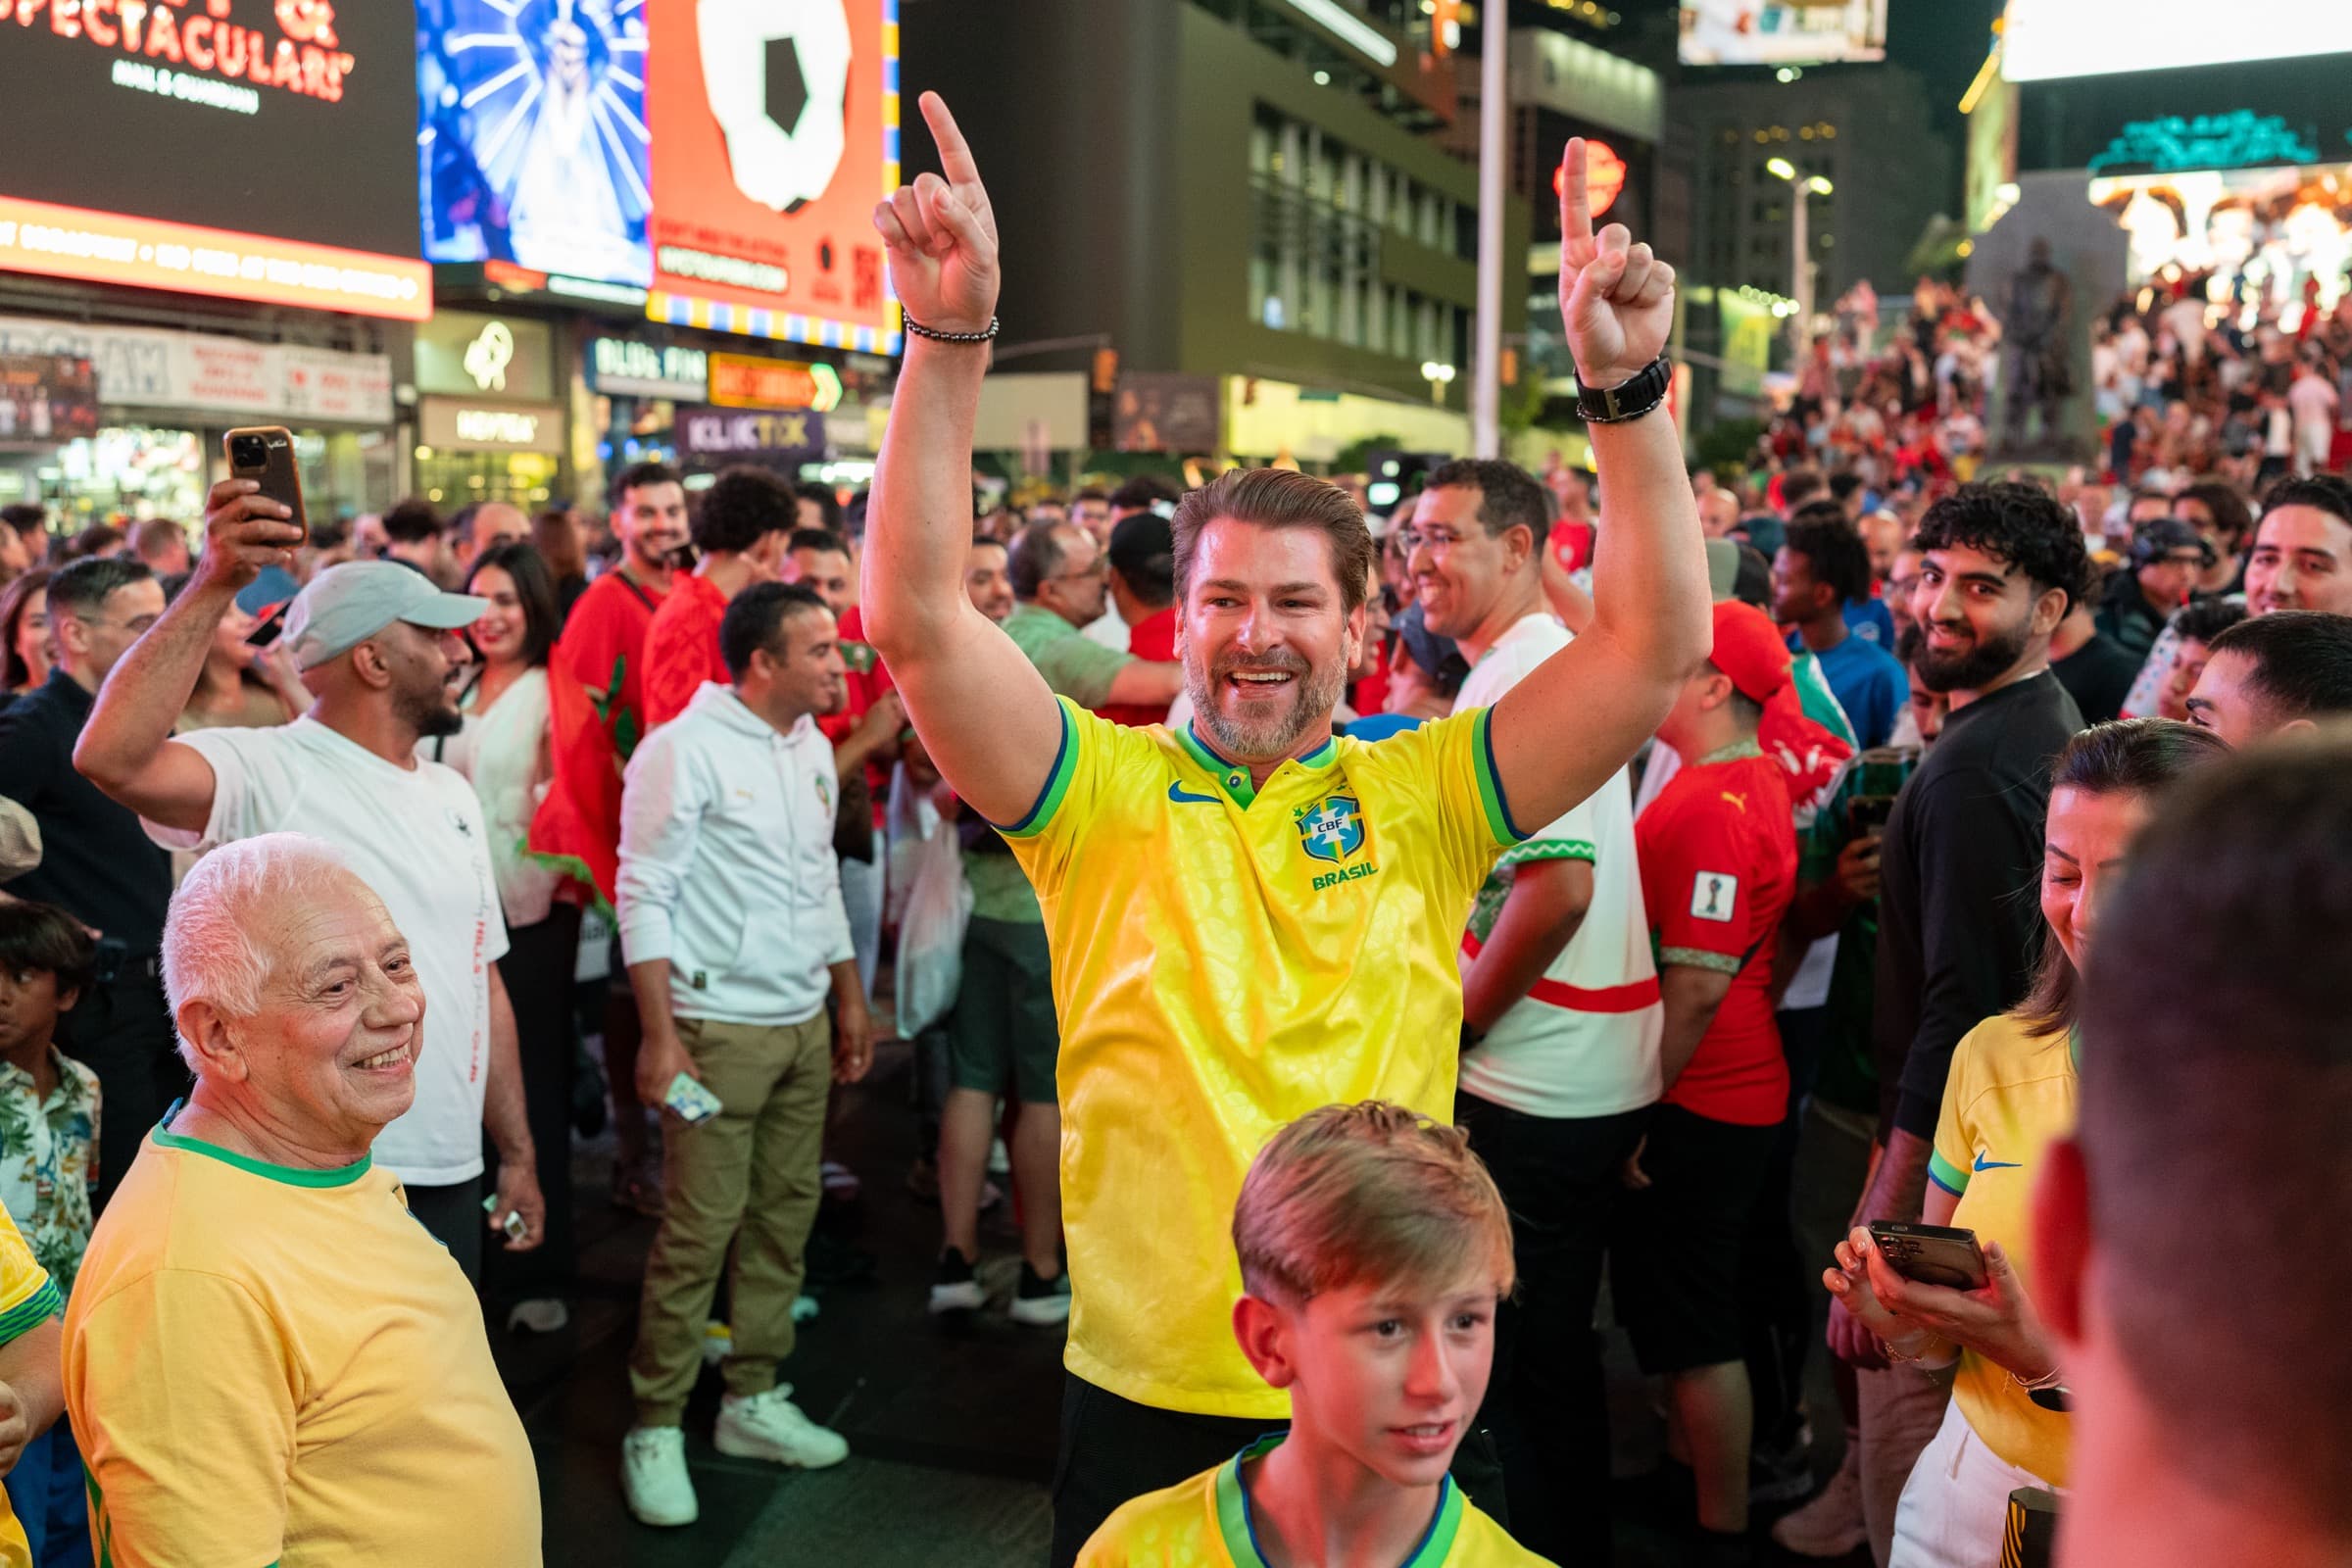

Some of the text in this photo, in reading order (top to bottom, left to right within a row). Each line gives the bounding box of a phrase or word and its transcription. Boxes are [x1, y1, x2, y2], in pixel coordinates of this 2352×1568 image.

[689, 416, 808, 452] KLIKTIX
[1317, 818, 1343, 833] CBF
[1312, 862, 1379, 891] BRASIL
